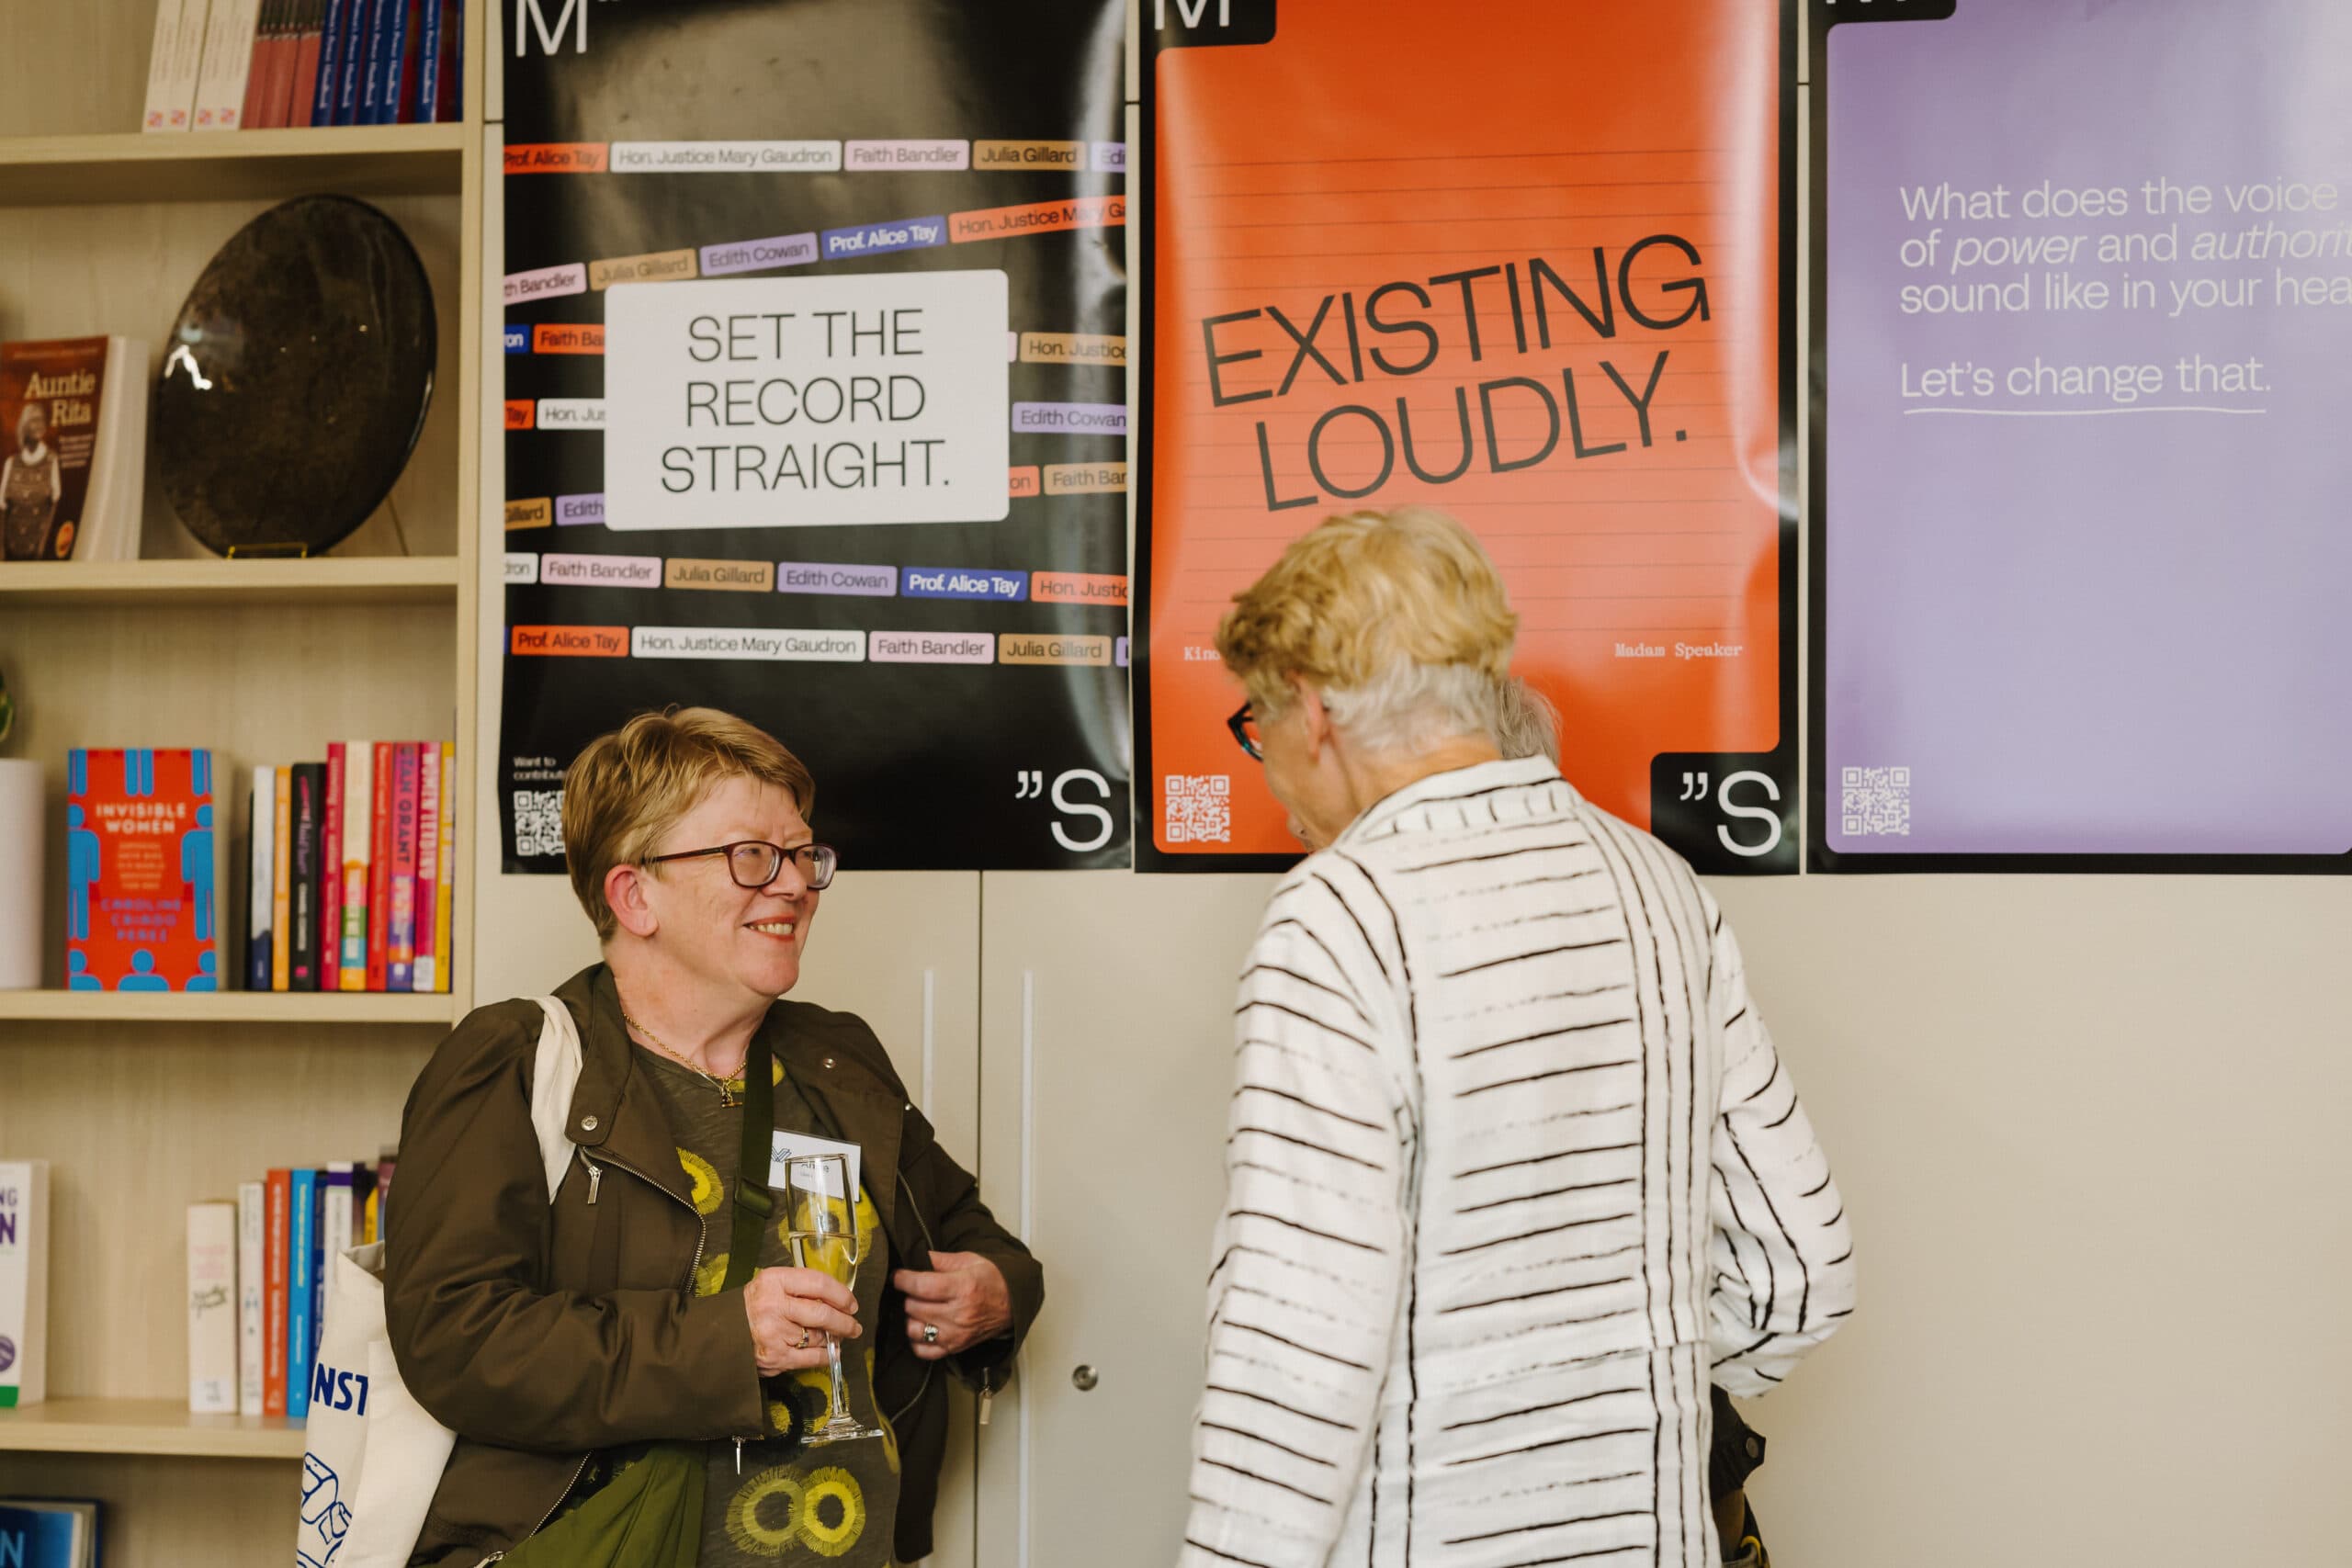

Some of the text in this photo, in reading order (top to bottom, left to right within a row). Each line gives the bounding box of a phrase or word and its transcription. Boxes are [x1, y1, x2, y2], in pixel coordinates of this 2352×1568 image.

[534, 151, 571, 164] Alice
[573, 150, 602, 167] Tay
[619, 147, 831, 167] Hon. Justice Mary Gaudron
[853, 147, 960, 164] Faith Bandler
[982, 147, 1077, 164] Julia Gillard
[1900, 175, 2338, 221] What does the voice
[958, 218, 994, 234] Hon.
[999, 209, 1059, 229] Justice
[830, 225, 938, 253] Prof. Alice Tay
[1900, 228, 1942, 267] of
[1951, 234, 2088, 275] power
[2098, 222, 2177, 263] and
[708, 243, 809, 267] Edith Cowan
[599, 256, 688, 281] Julia Gillard
[520, 273, 577, 294] Bandler
[1900, 271, 2030, 314] sound
[2045, 271, 2110, 310] like
[2123, 272, 2155, 310] in
[2168, 278, 2262, 317] your
[1202, 234, 1711, 408] EXISTING
[540, 331, 578, 346] Faith
[688, 309, 923, 362] SET THE
[1029, 340, 1065, 355] Hon.
[24, 368, 96, 400] Auntie
[2007, 356, 2163, 402] change
[2176, 354, 2271, 393] that.
[687, 375, 925, 428] RECORD
[51, 399, 91, 427] Rita
[545, 407, 579, 422] Hon.
[1022, 408, 1064, 426] Edith
[1255, 350, 1687, 512] LOUDLY.
[662, 440, 949, 493] STRAIGHT.
[1053, 469, 1094, 487] Faith
[548, 561, 653, 579] Faith Bandler
[673, 566, 764, 584] Julia Gillard
[786, 570, 888, 589] Edith Cowan
[910, 573, 1020, 598] Prof. Alice Tay
[1040, 580, 1076, 595] Hon.
[552, 631, 591, 649] Alice
[593, 634, 620, 652] Tay
[640, 636, 856, 655] Hon. Justice Mary Gaudron
[878, 638, 985, 656] Faith Bandler
[1007, 641, 1102, 659] Julia Gillard
[1614, 643, 1743, 660] Madam Speaker
[96, 802, 187, 818] INVISIBLE
[105, 819, 175, 834] WOMEN
